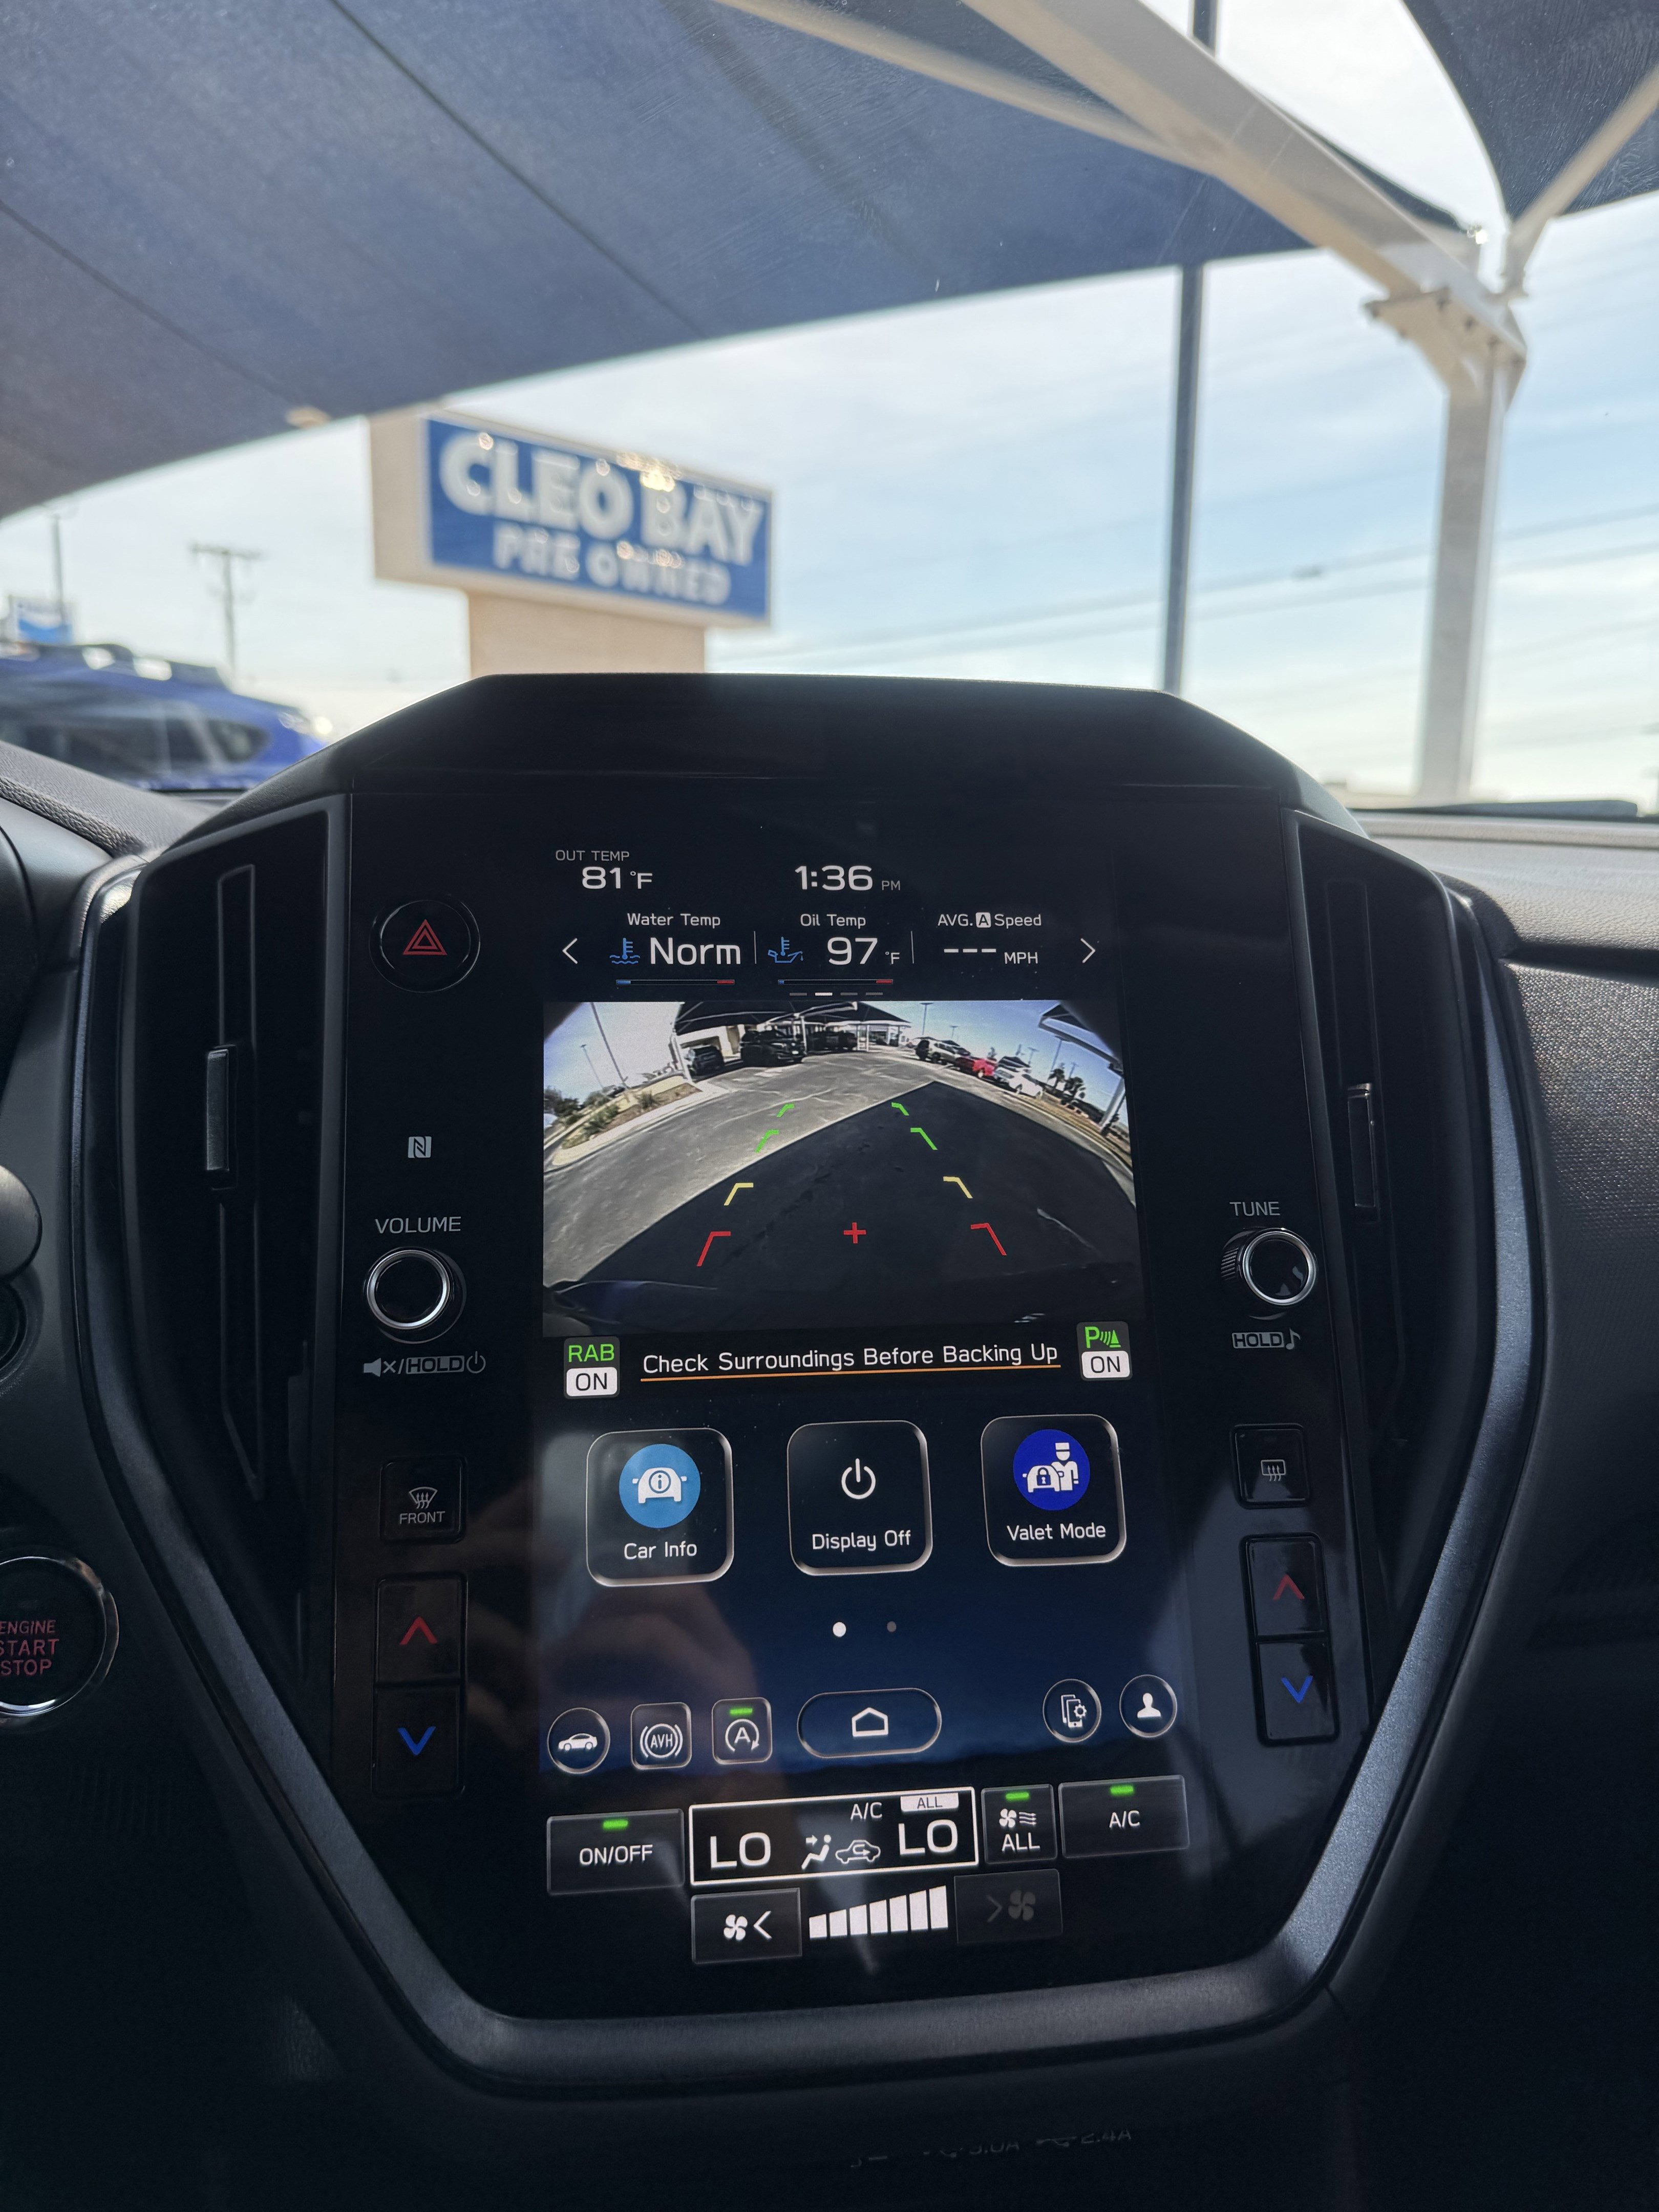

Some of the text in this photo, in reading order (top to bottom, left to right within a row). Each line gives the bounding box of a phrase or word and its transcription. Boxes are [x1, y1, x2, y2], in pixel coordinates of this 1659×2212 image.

[438, 431, 764, 566] CLEO BAY
[493, 523, 580, 581] PRE
[555, 850, 630, 861] OUT TEMP
[795, 865, 901, 891] 1:36 PM
[627, 912, 721, 929] Water Temp
[800, 913, 866, 929] Oil Temp
[937, 913, 973, 927] AVG.
[994, 913, 1042, 929] Speed
[650, 937, 741, 965] Norm
[826, 937, 878, 965] 97
[1004, 952, 1038, 965] MPH
[1229, 1201, 1281, 1216] TUNE
[374, 1216, 461, 1234] VOLUME
[1233, 1333, 1283, 1348] HOLD
[568, 1343, 615, 1363] RAB
[643, 1342, 1058, 1374] Check Surroundings Before Backing Up
[408, 1356, 464, 1373] HOLD
[1090, 1355, 1121, 1374] ON
[575, 1371, 608, 1392] ON
[399, 1511, 445, 1525] FRONT
[812, 1529, 912, 1552] Display Off
[1007, 1521, 1107, 1541] Valet Mode
[624, 1540, 698, 1560] Car Info
[0, 1620, 56, 1635] ENGINE
[0, 1658, 53, 1676] STOP
[649, 1733, 674, 1749] AVH
[850, 1796, 944, 1821] A/C ALL
[1109, 1809, 1141, 1830] A/C
[898, 1818, 959, 1856] LO
[1001, 1832, 1041, 1853] ALL
[579, 1843, 654, 1867] ON/OFF
[710, 1831, 772, 1870] LO
